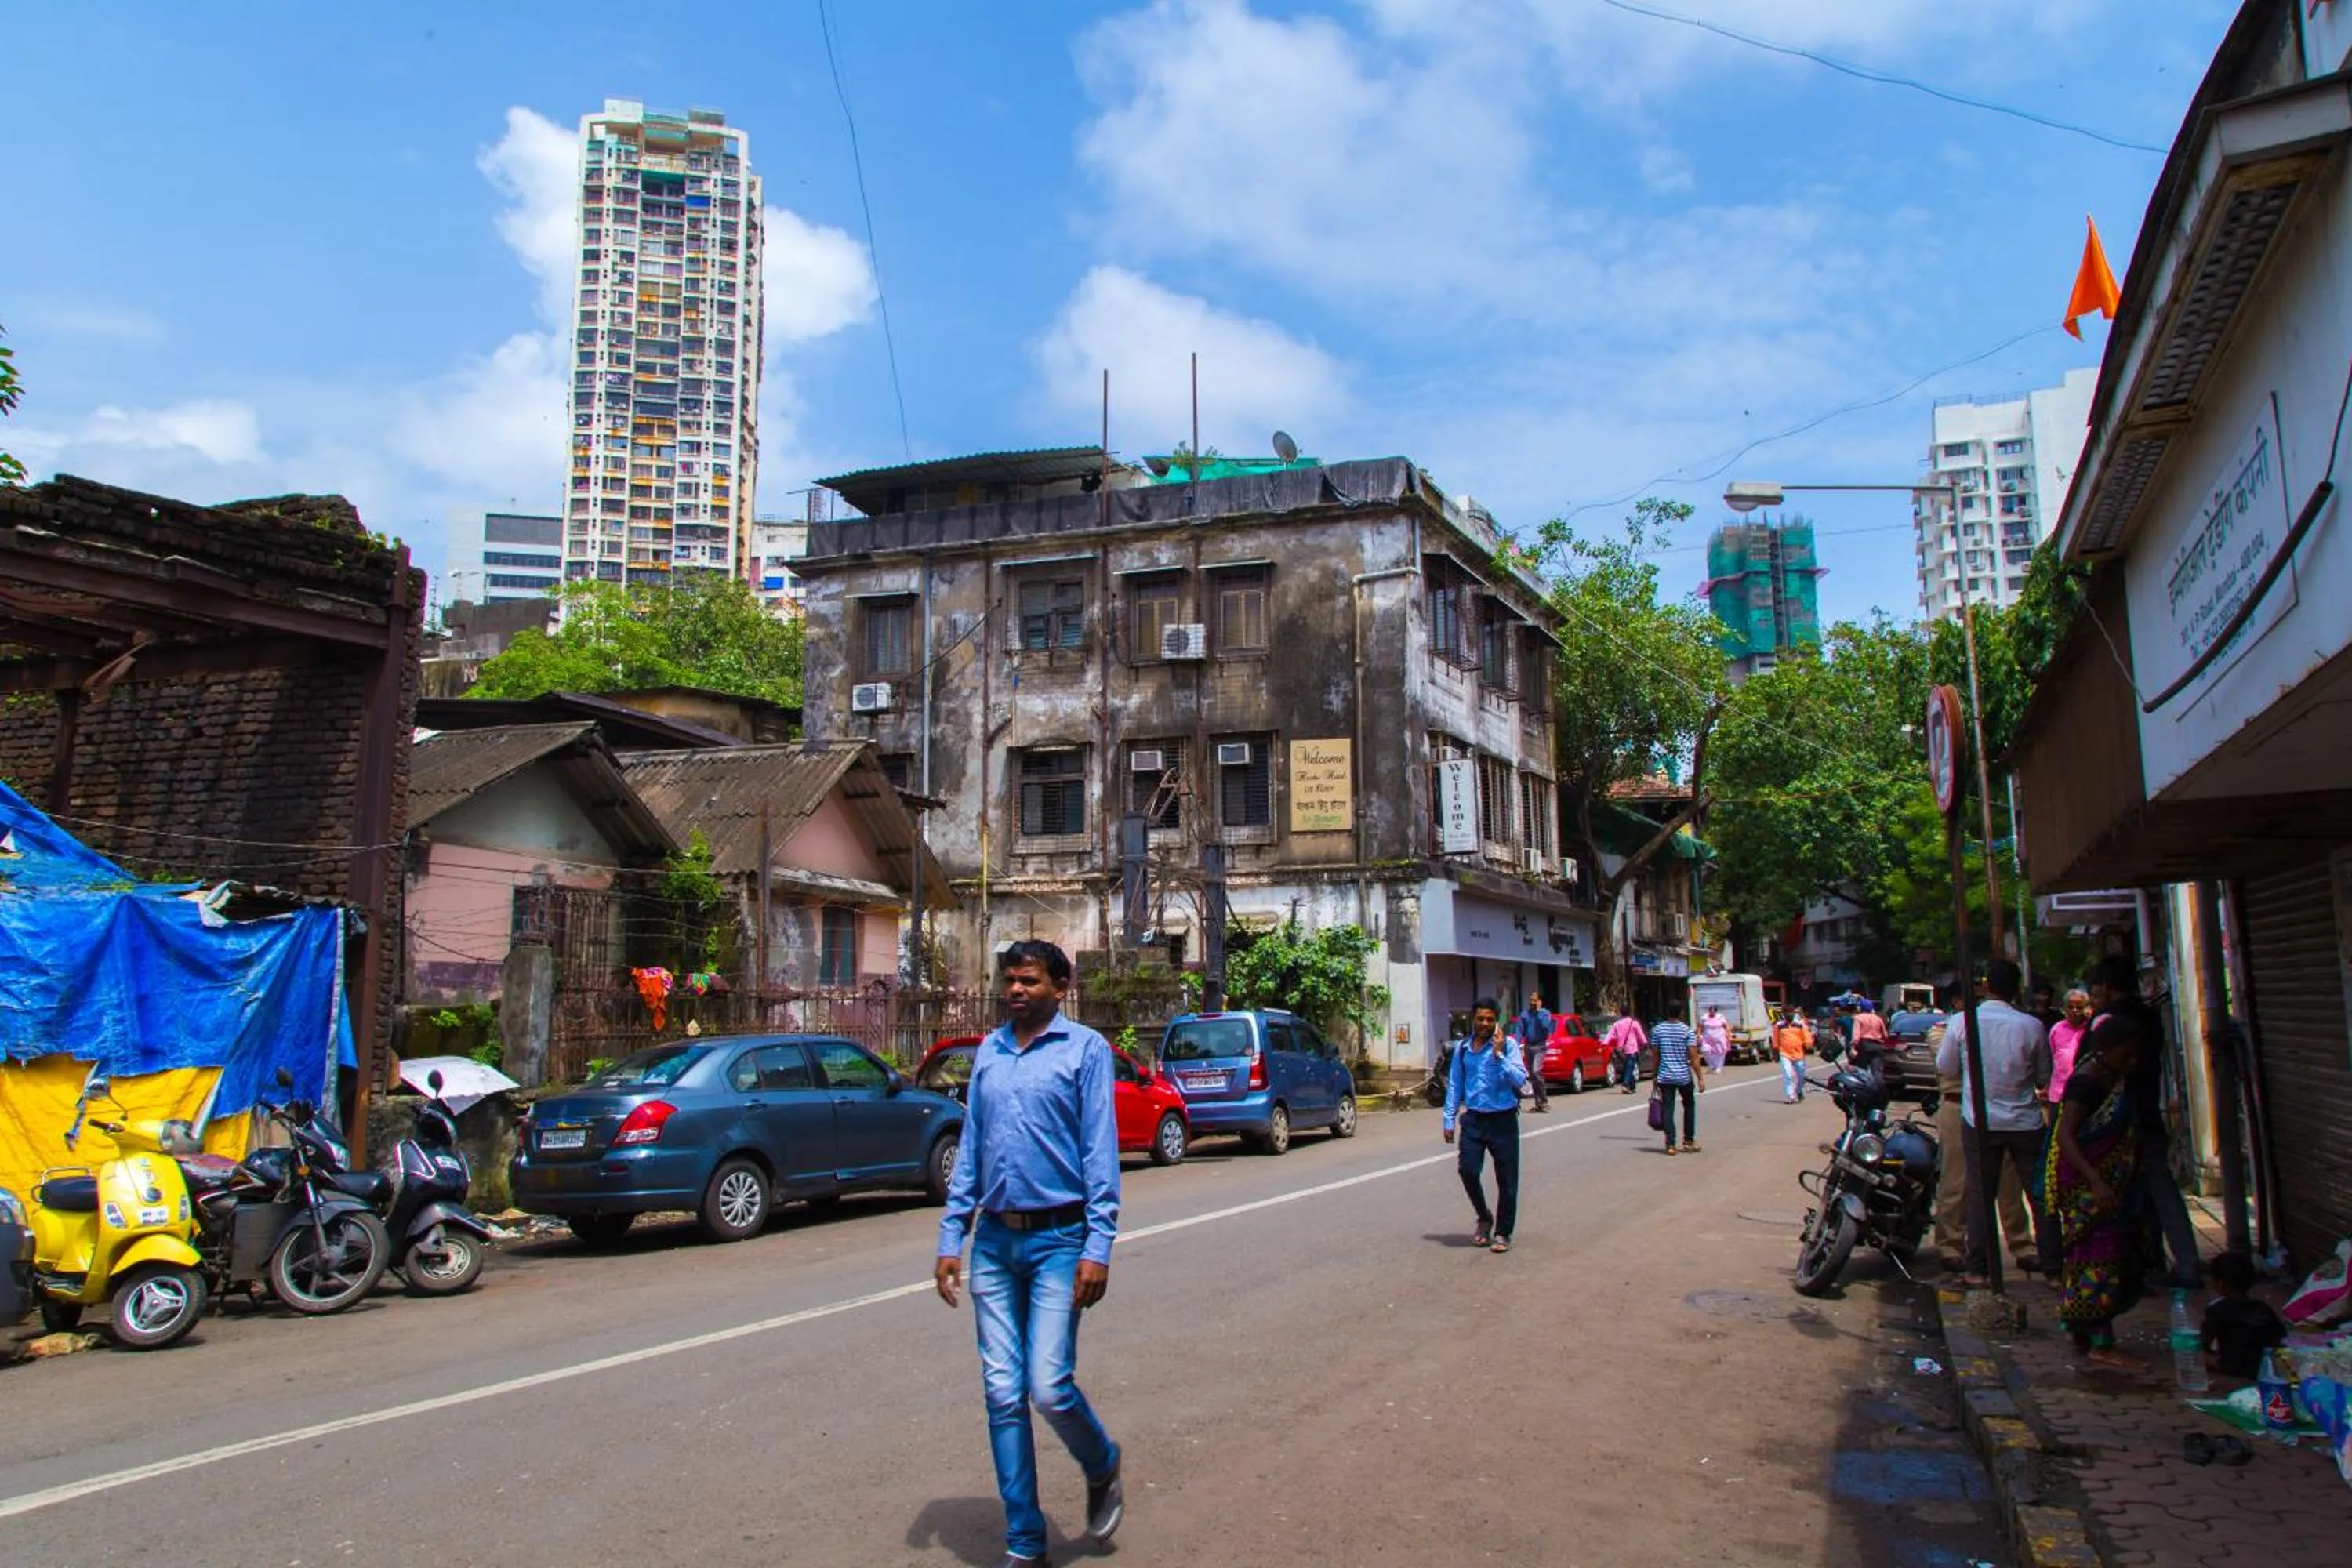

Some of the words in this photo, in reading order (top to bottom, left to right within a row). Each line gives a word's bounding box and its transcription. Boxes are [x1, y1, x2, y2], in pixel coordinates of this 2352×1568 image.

[2233, 426, 2269, 514] कंपनी
[1294, 746, 1345, 764] Welcome
[1448, 763, 1465, 830] Welcome
